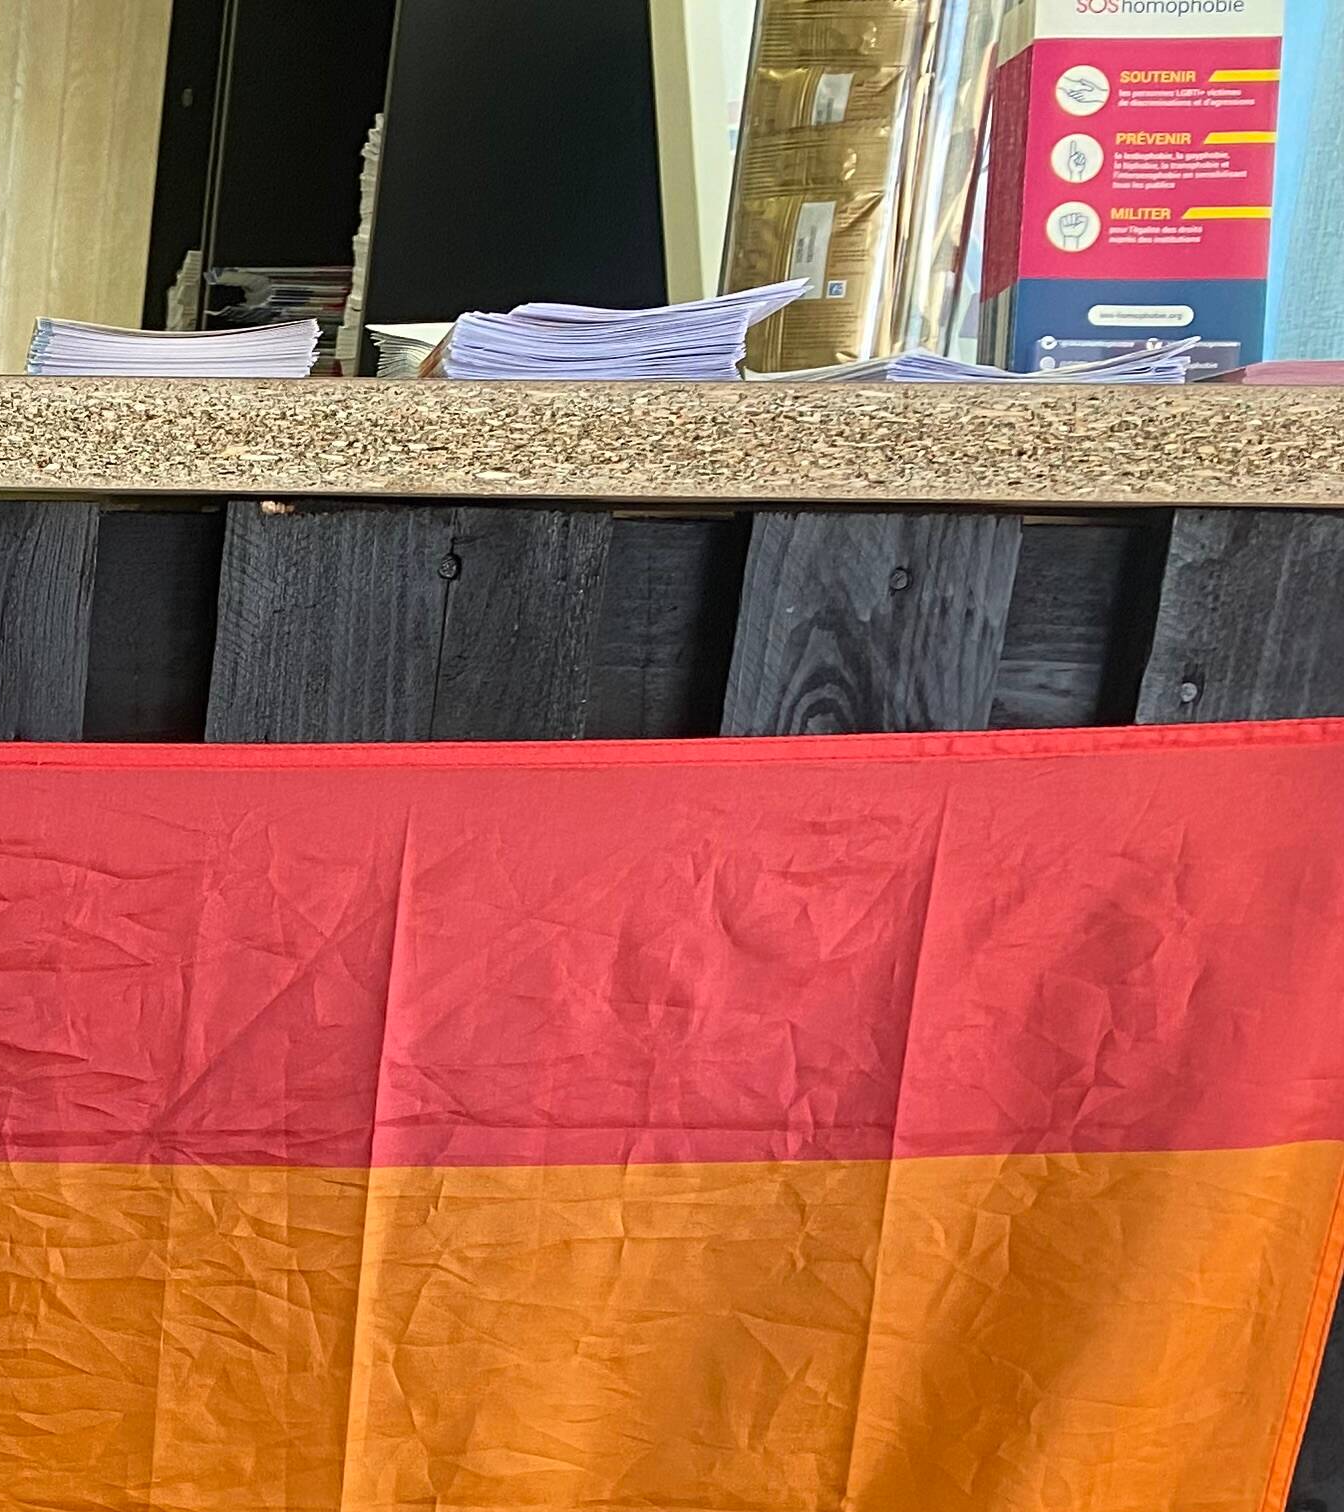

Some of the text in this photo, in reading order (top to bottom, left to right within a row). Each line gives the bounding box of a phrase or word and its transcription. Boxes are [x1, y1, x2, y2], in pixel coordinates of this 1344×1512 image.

[1119, 71, 1197, 84] SOUTENIR
[1115, 131, 1192, 145] PRÉVENIR
[1111, 207, 1171, 220] MILITER
